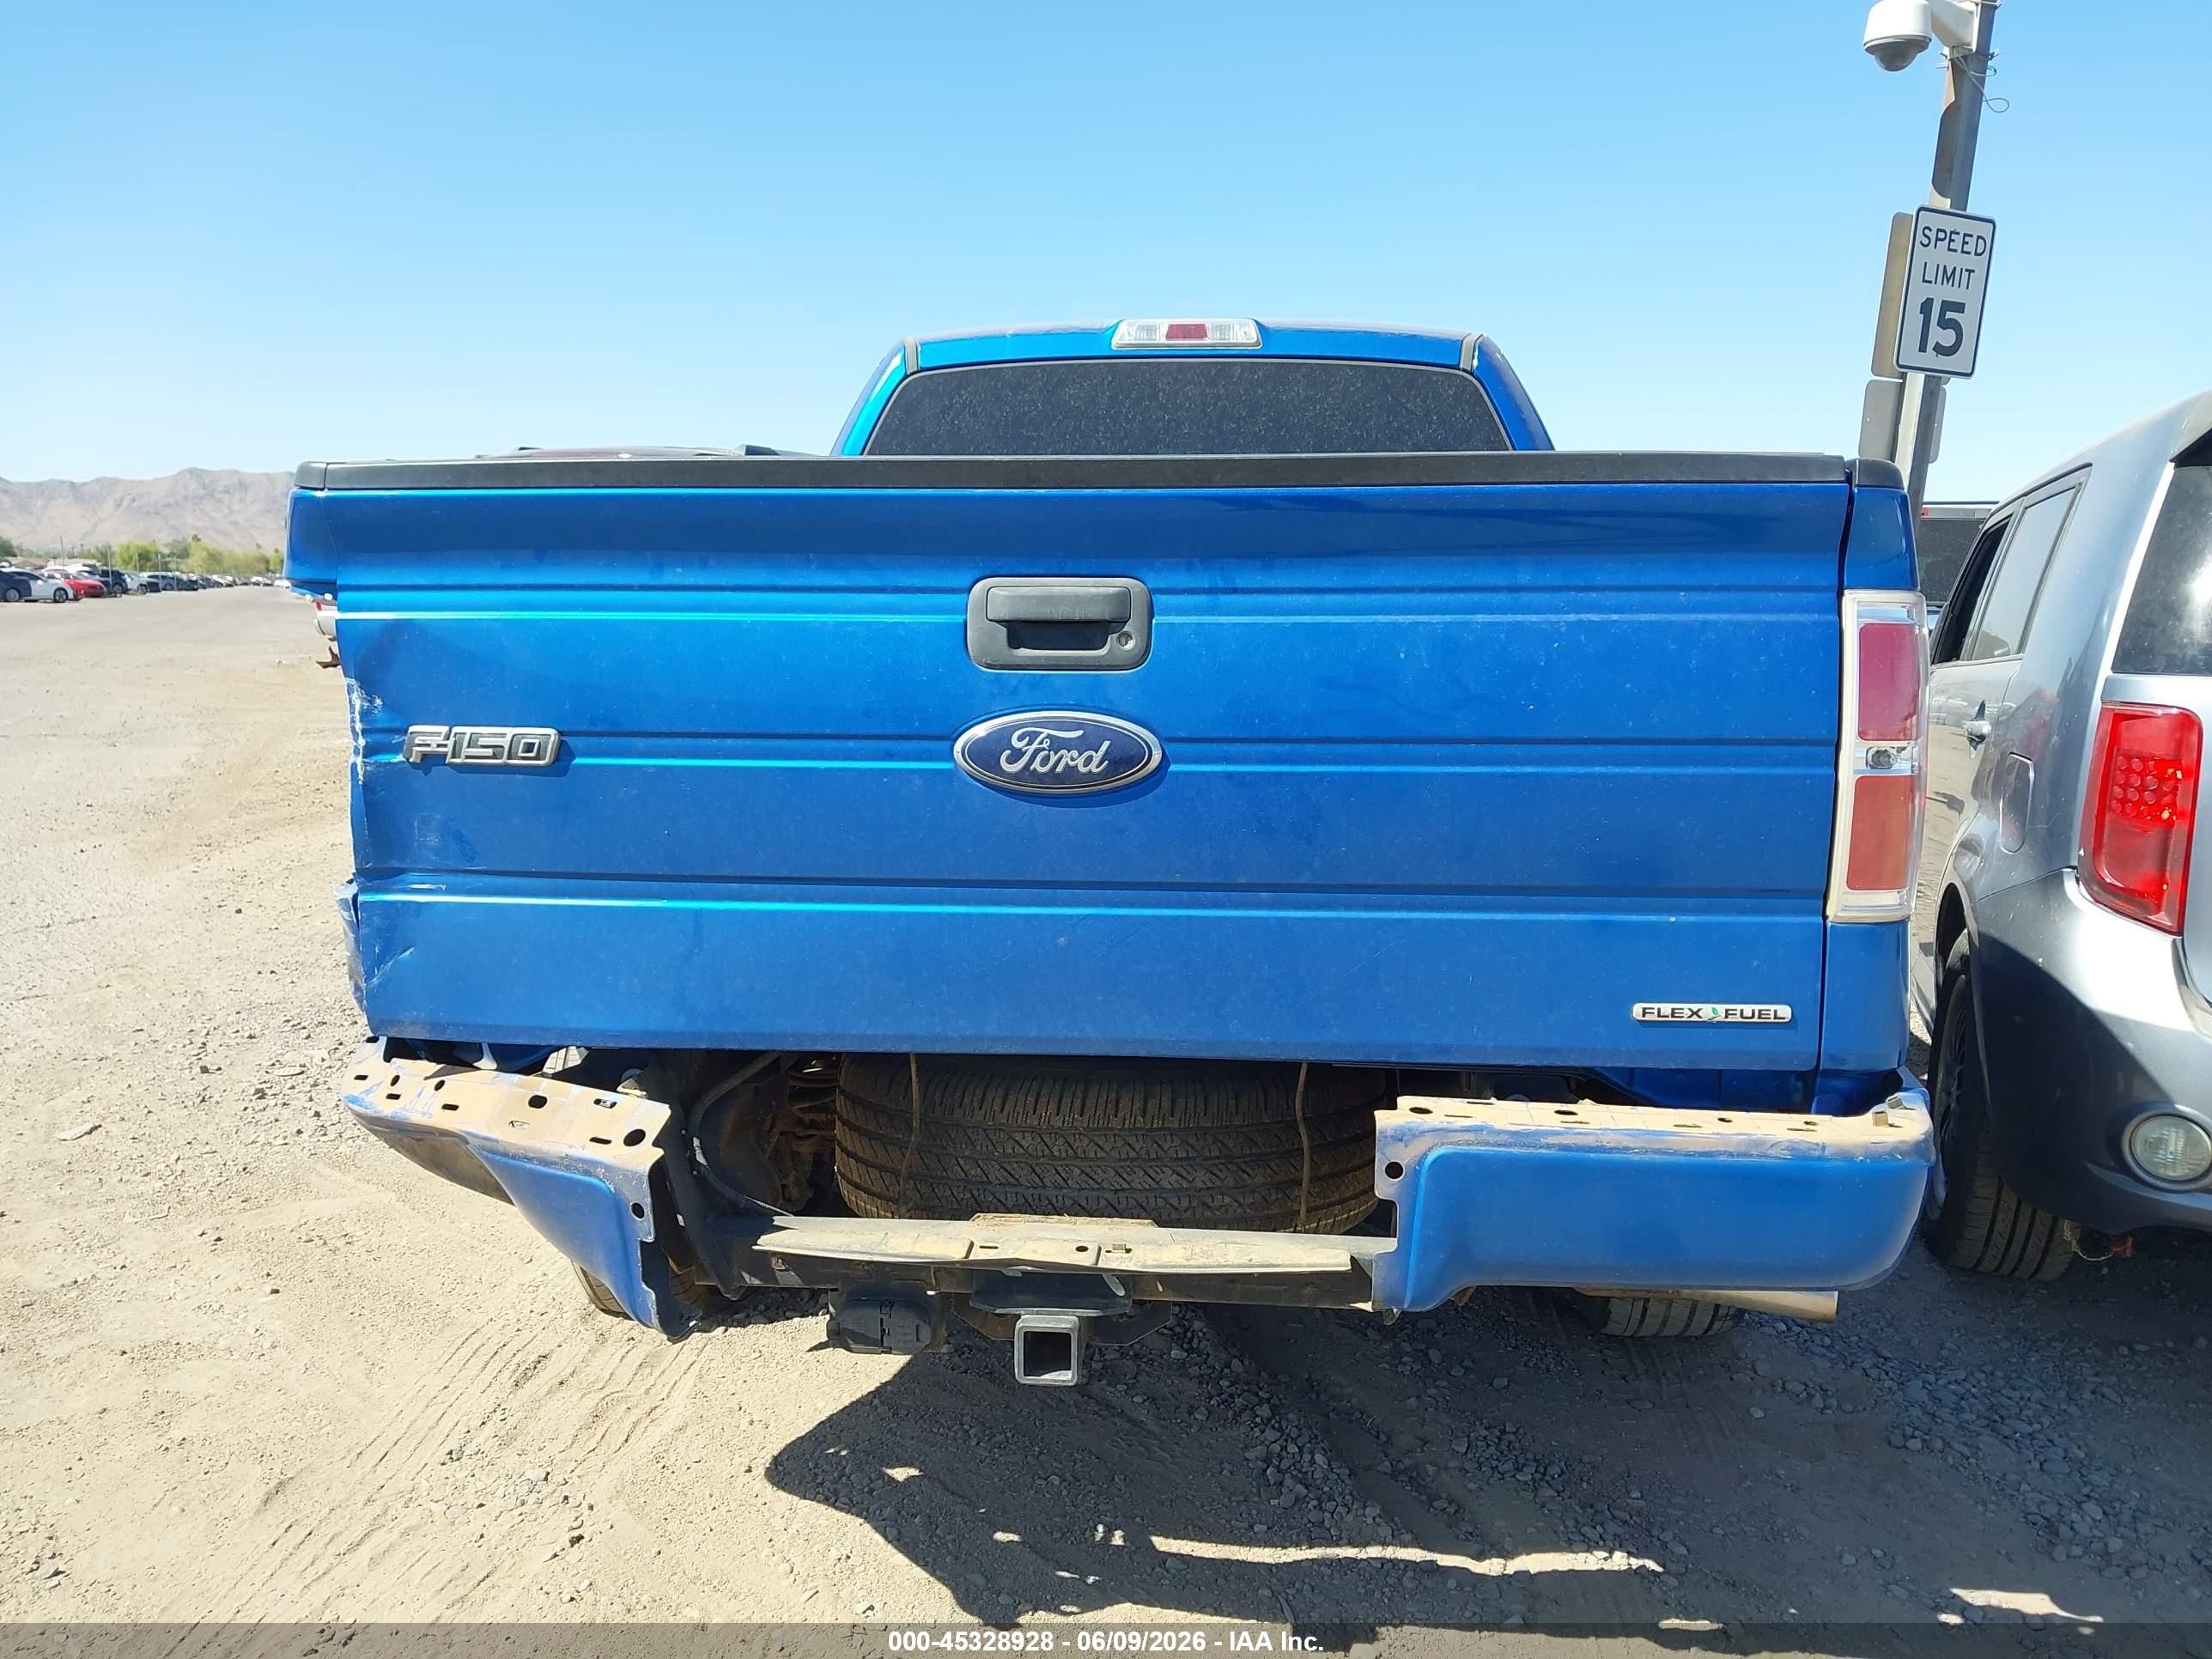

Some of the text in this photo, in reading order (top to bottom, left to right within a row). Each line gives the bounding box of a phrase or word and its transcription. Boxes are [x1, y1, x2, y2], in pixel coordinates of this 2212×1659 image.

[1919, 225, 1987, 257] SPEED
[1922, 261, 1976, 290] LIMIT
[1917, 297, 1966, 357] 15
[404, 725, 561, 766] F-150
[1000, 727, 1111, 774] Ford
[1641, 1006, 1787, 1020] FLEX FUEL
